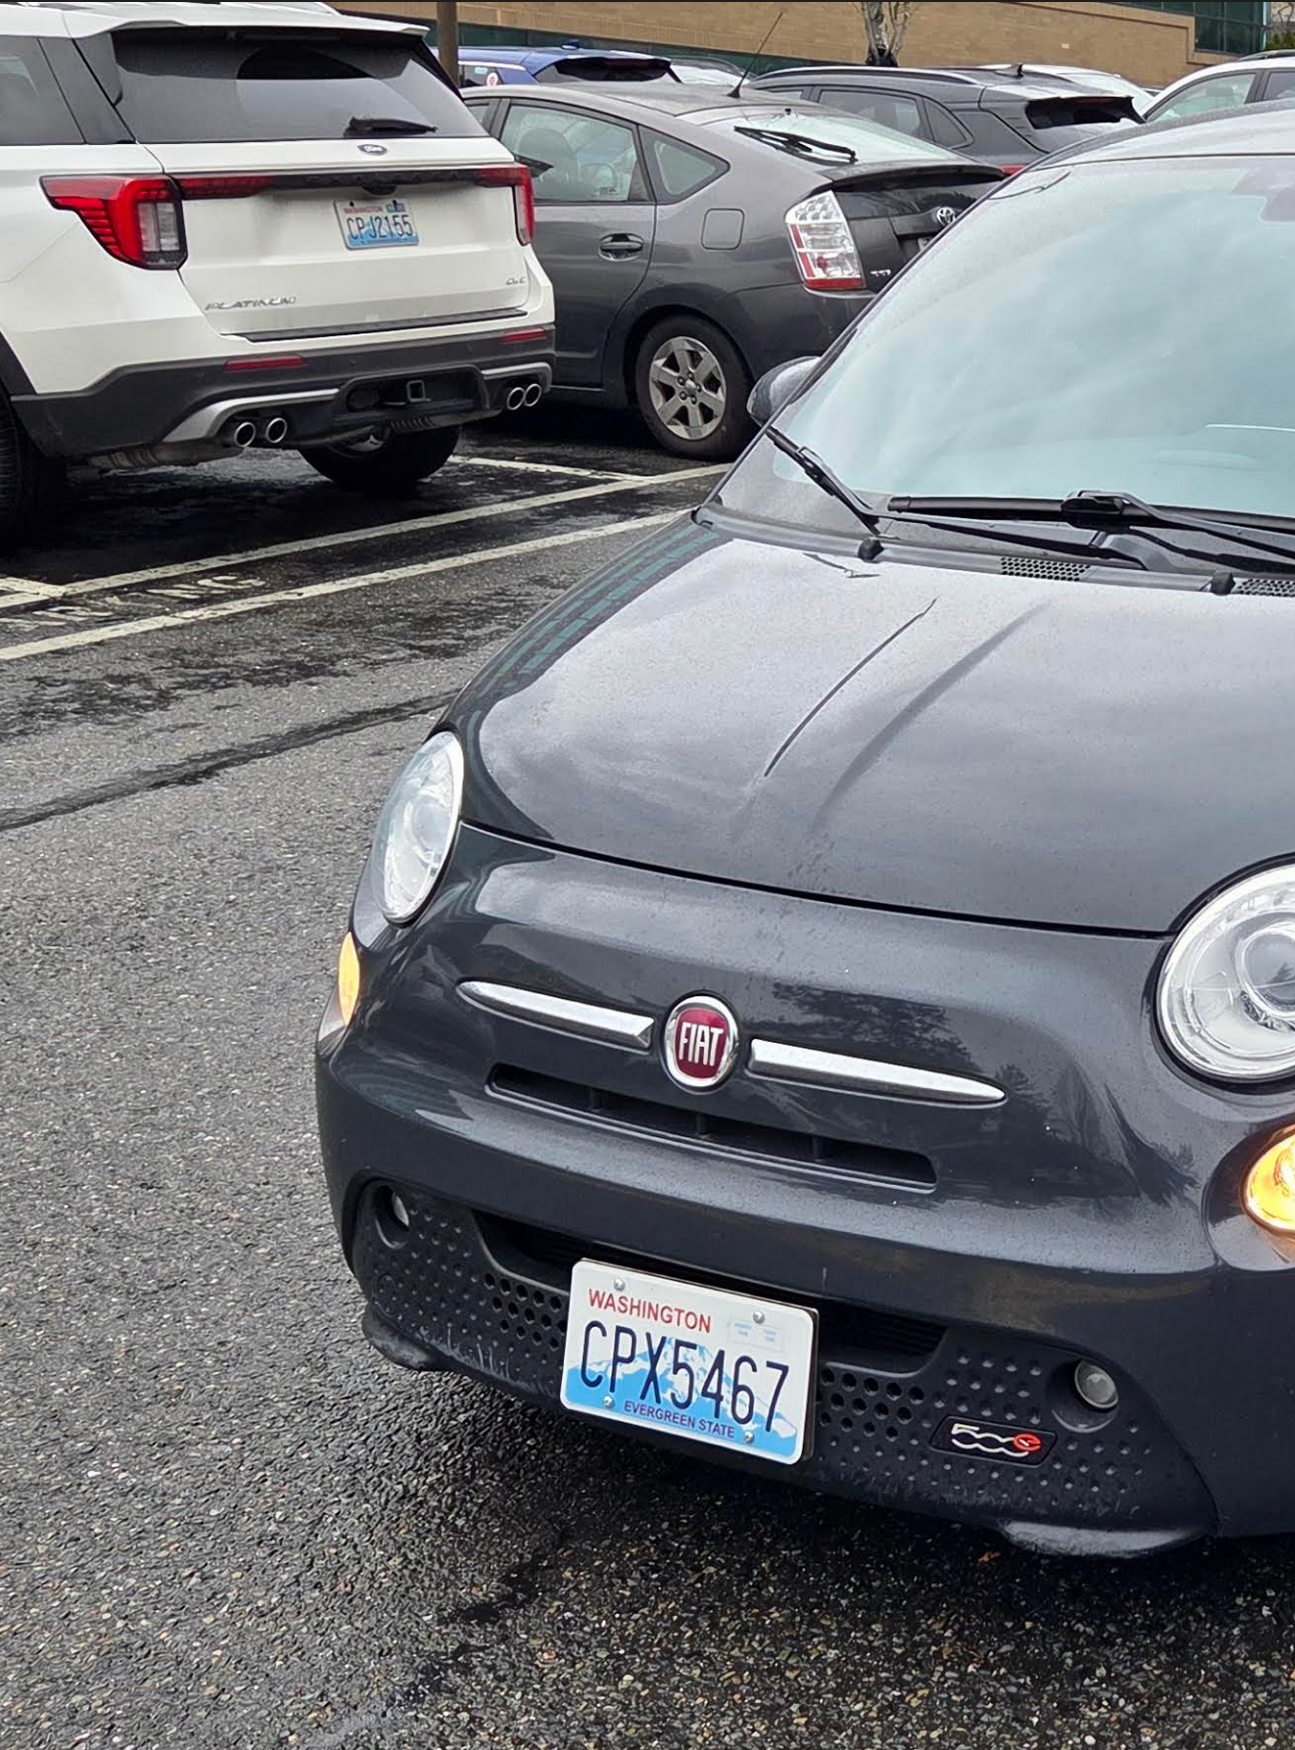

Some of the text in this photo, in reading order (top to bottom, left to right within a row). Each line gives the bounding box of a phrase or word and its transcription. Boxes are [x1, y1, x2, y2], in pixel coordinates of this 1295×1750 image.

[347, 214, 413, 240] CPJ2155
[679, 1021, 725, 1067] FIAT
[588, 1288, 712, 1334] WASHINGTON
[580, 1320, 790, 1433] CPX5467
[623, 1400, 736, 1439] EVERGREEN STATE
